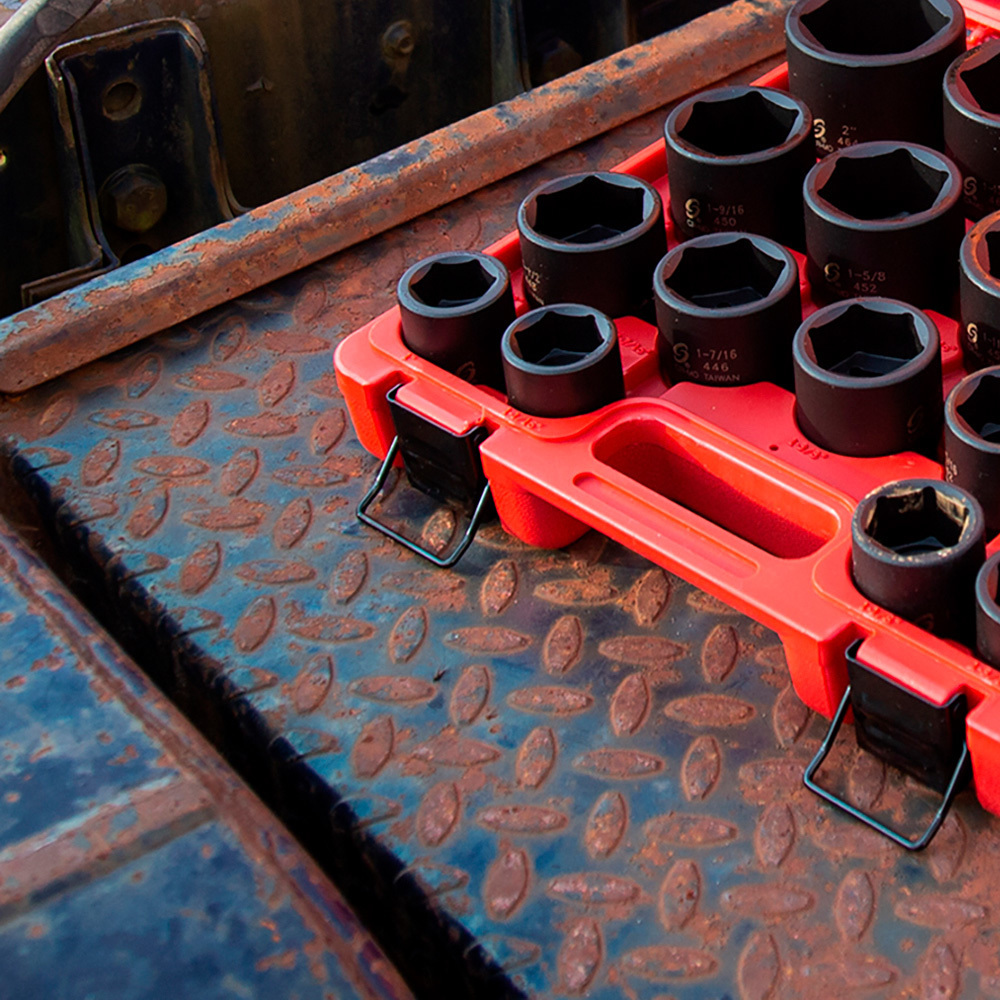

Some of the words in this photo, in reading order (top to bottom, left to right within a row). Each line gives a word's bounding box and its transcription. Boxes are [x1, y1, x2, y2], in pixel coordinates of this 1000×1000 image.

[848, 268, 887, 282] 1-5/8
[696, 348, 738, 361] 1-7/16
[703, 361, 729, 373] 446
[703, 373, 741, 382] TAIWAN
